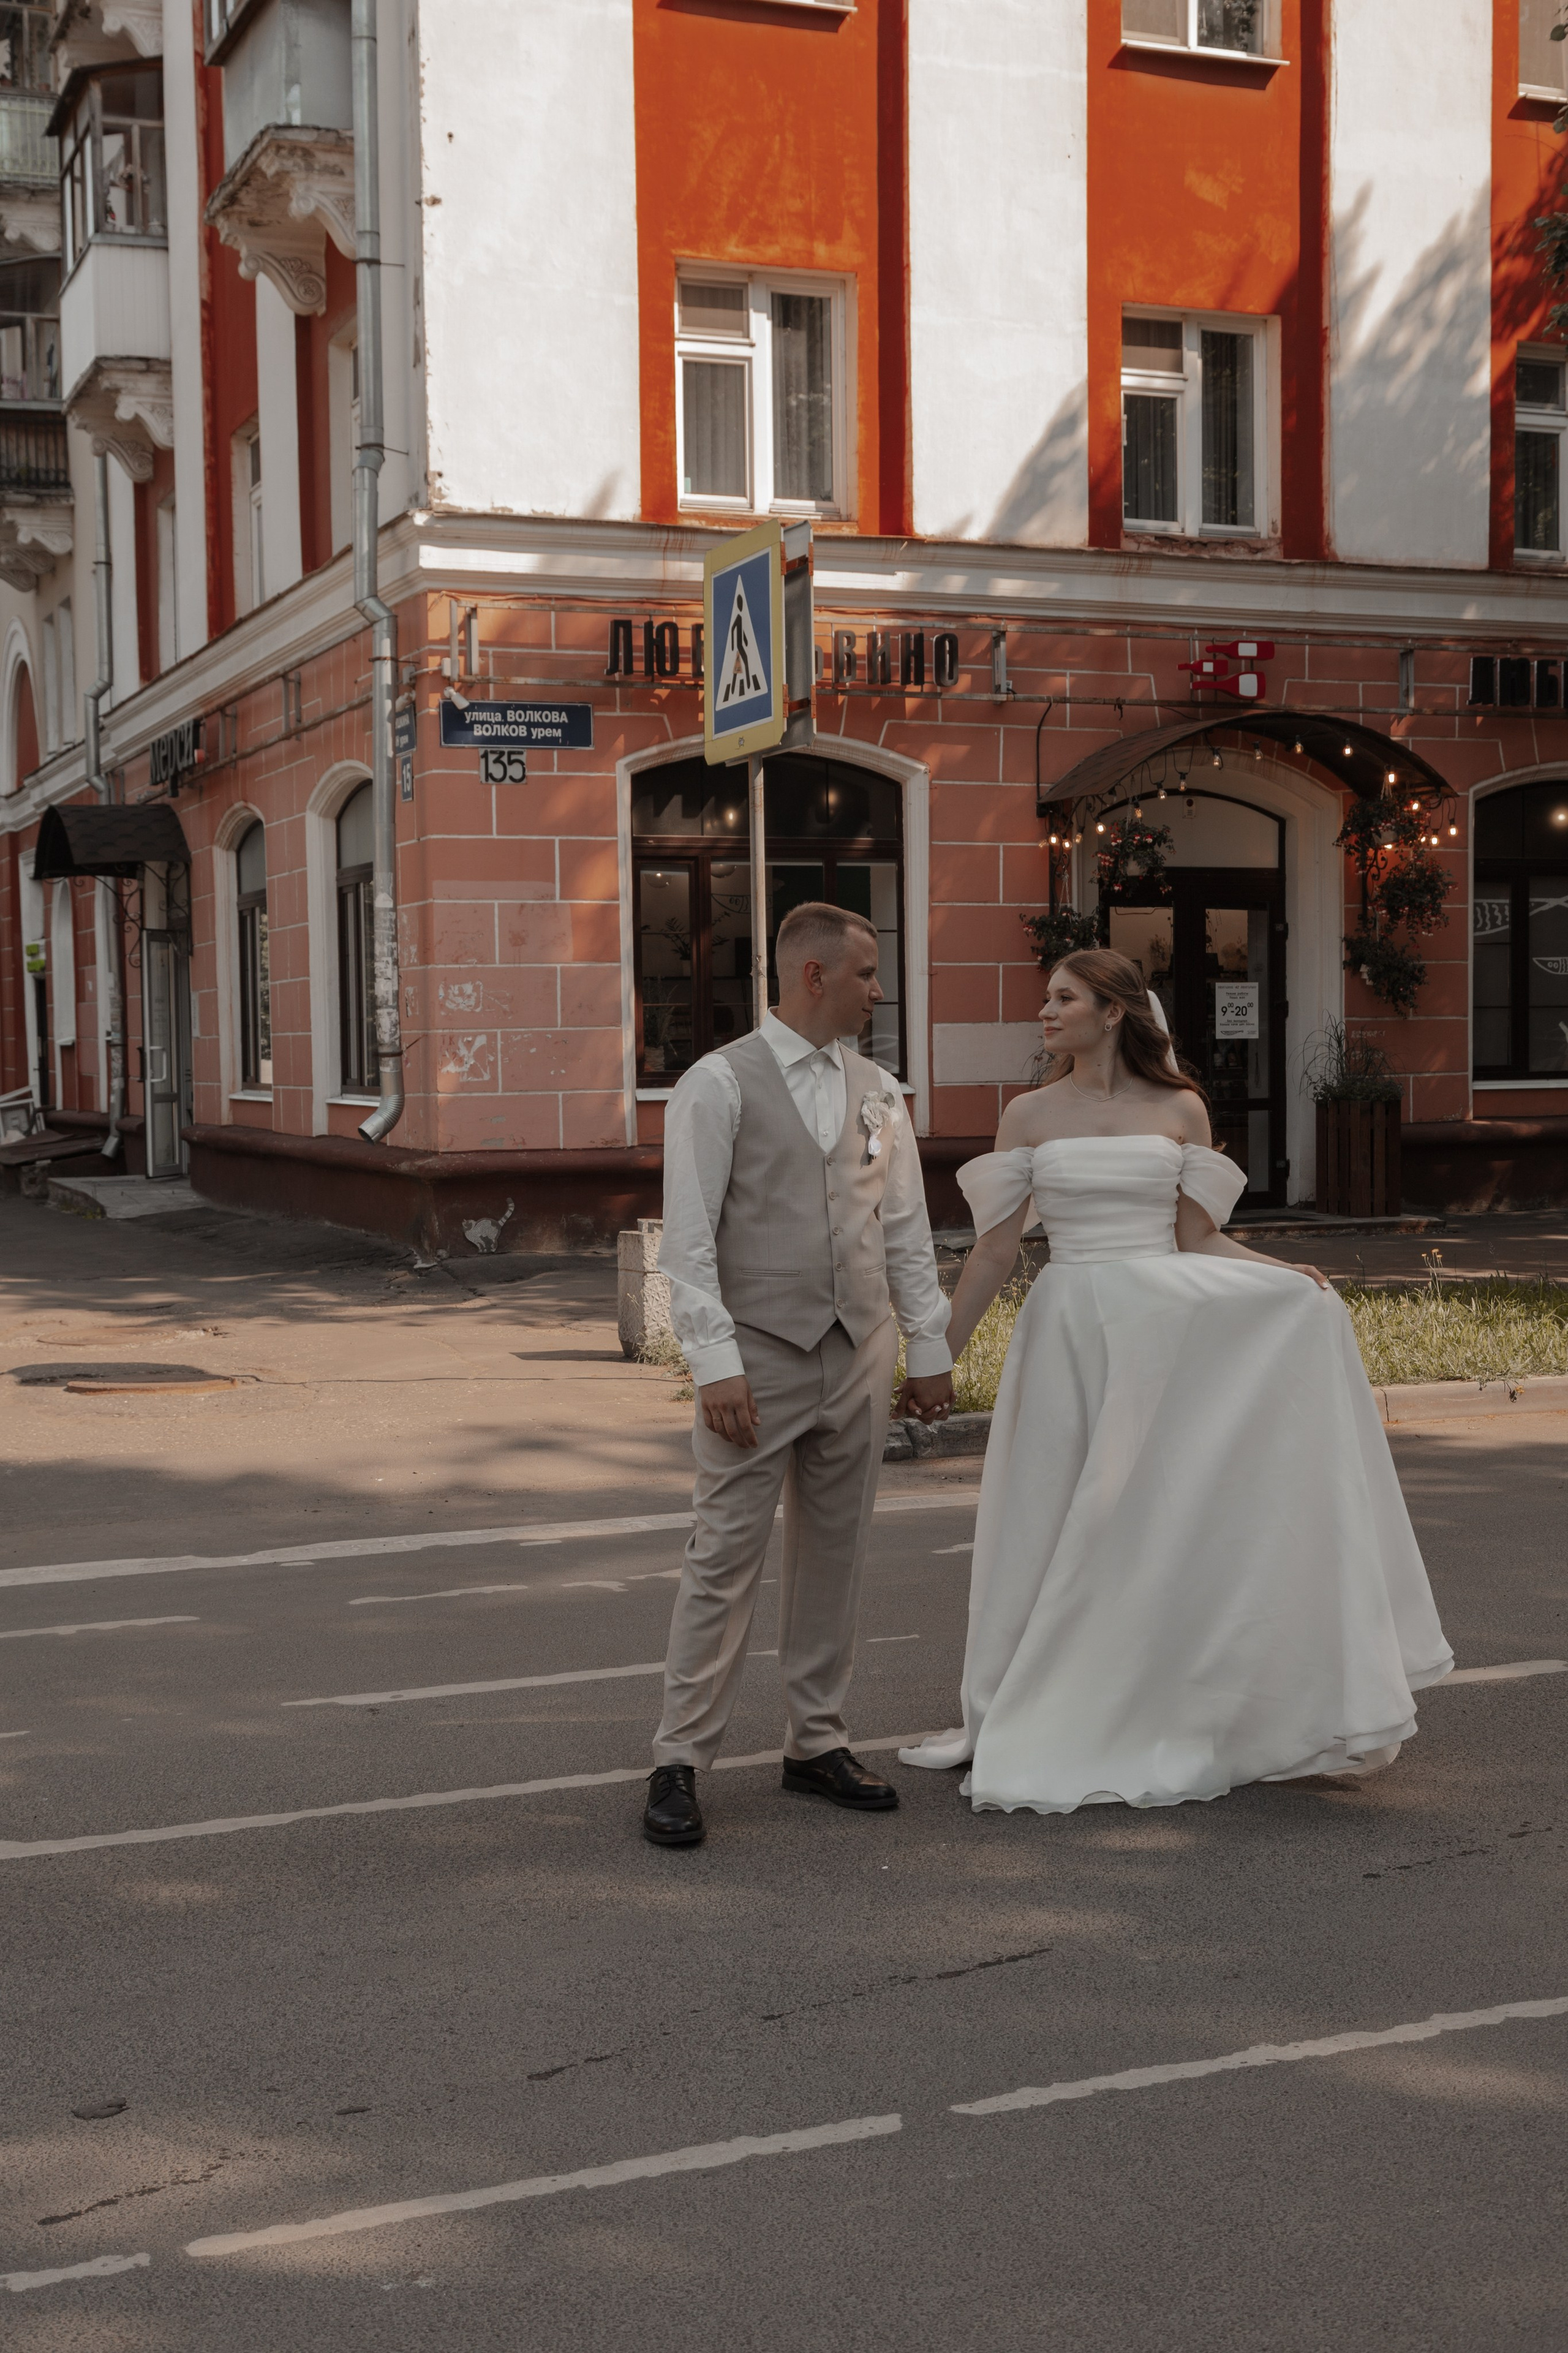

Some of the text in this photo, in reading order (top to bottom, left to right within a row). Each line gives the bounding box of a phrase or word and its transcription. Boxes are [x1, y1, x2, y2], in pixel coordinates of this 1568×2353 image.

[507, 710, 568, 723] ВОЛКОВА
[473, 724, 562, 739] ВОЛКОВ урем
[480, 749, 526, 784] 135
[402, 763, 410, 793] 15
